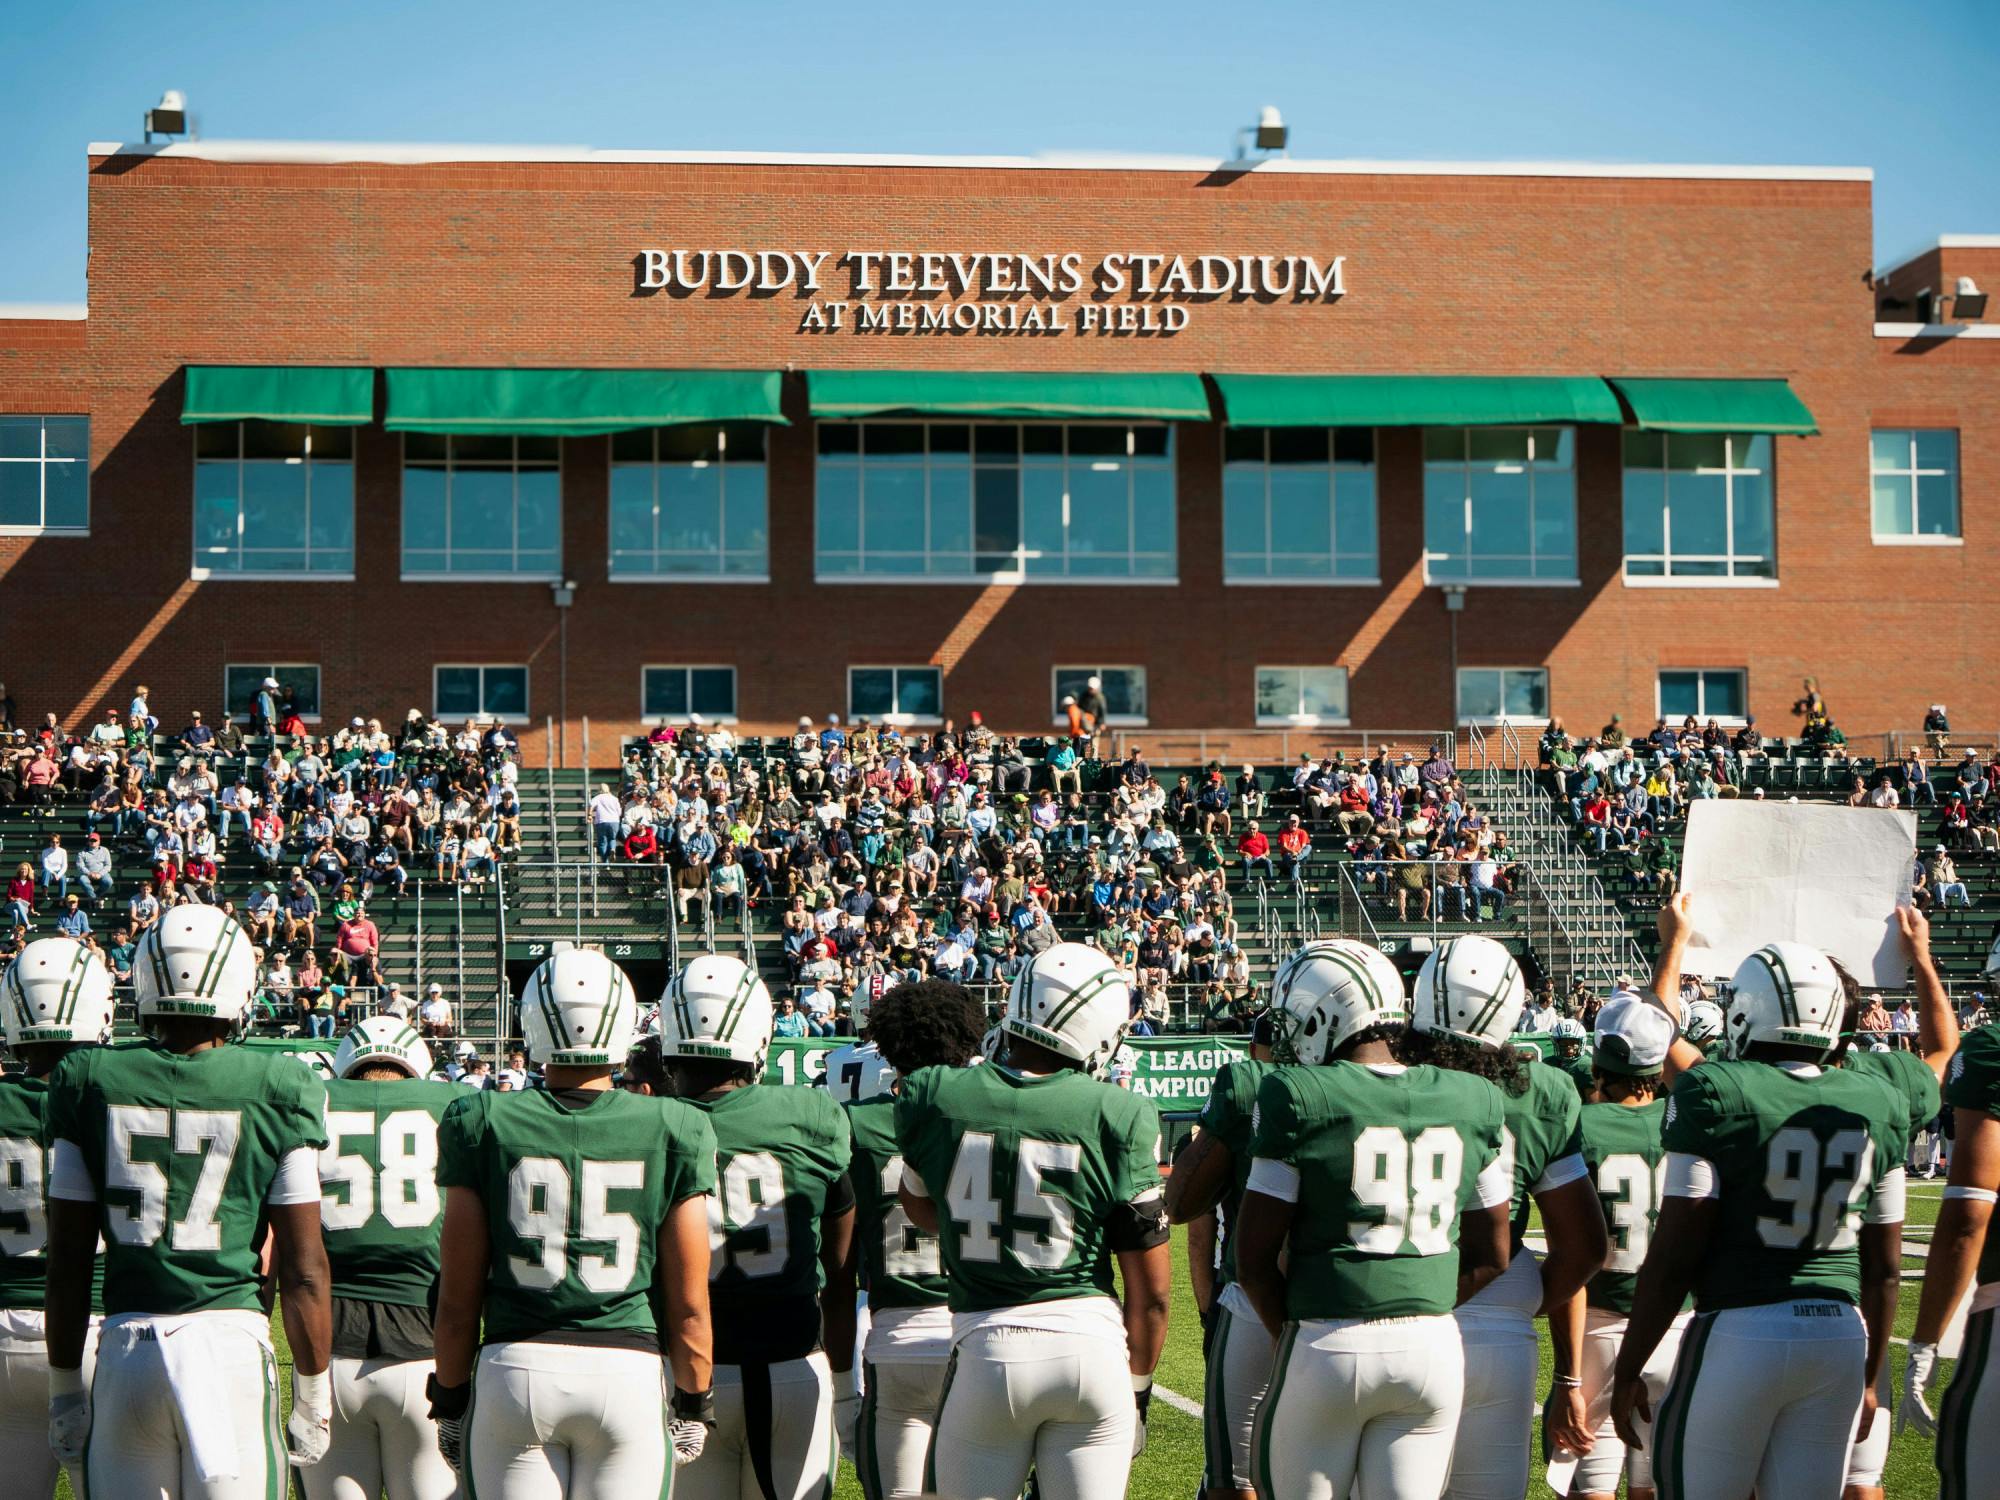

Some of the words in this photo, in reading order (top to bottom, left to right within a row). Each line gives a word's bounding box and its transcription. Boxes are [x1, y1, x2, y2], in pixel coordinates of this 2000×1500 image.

[639, 249, 832, 290] BUDDY
[847, 251, 1082, 293] TEEVENS
[1101, 253, 1346, 296] STADIUM
[802, 302, 849, 328] AT
[859, 303, 1069, 330] MEMORIAL
[1081, 304, 1190, 331] FIELD
[529, 944, 544, 955] 22
[615, 944, 631, 955] 23
[1381, 941, 1396, 953] 23
[156, 1000, 176, 1012] THE
[19, 1030, 36, 1041] THE
[551, 1053, 571, 1063] THE
[678, 1043, 695, 1054] THE
[1132, 1077, 1215, 1098] AMPIO
[106, 1104, 242, 1251] 57
[320, 1110, 441, 1231] 58
[1347, 1127, 1463, 1257] 98
[1756, 1127, 1875, 1251] 92
[0, 1137, 57, 1257] 9
[708, 1151, 790, 1281] 9
[882, 1156, 943, 1276] 2
[944, 1130, 1081, 1270] 45
[1598, 1154, 1666, 1274] 3
[507, 1156, 645, 1293] 95
[1793, 1304, 1842, 1318] DARTMOUTH
